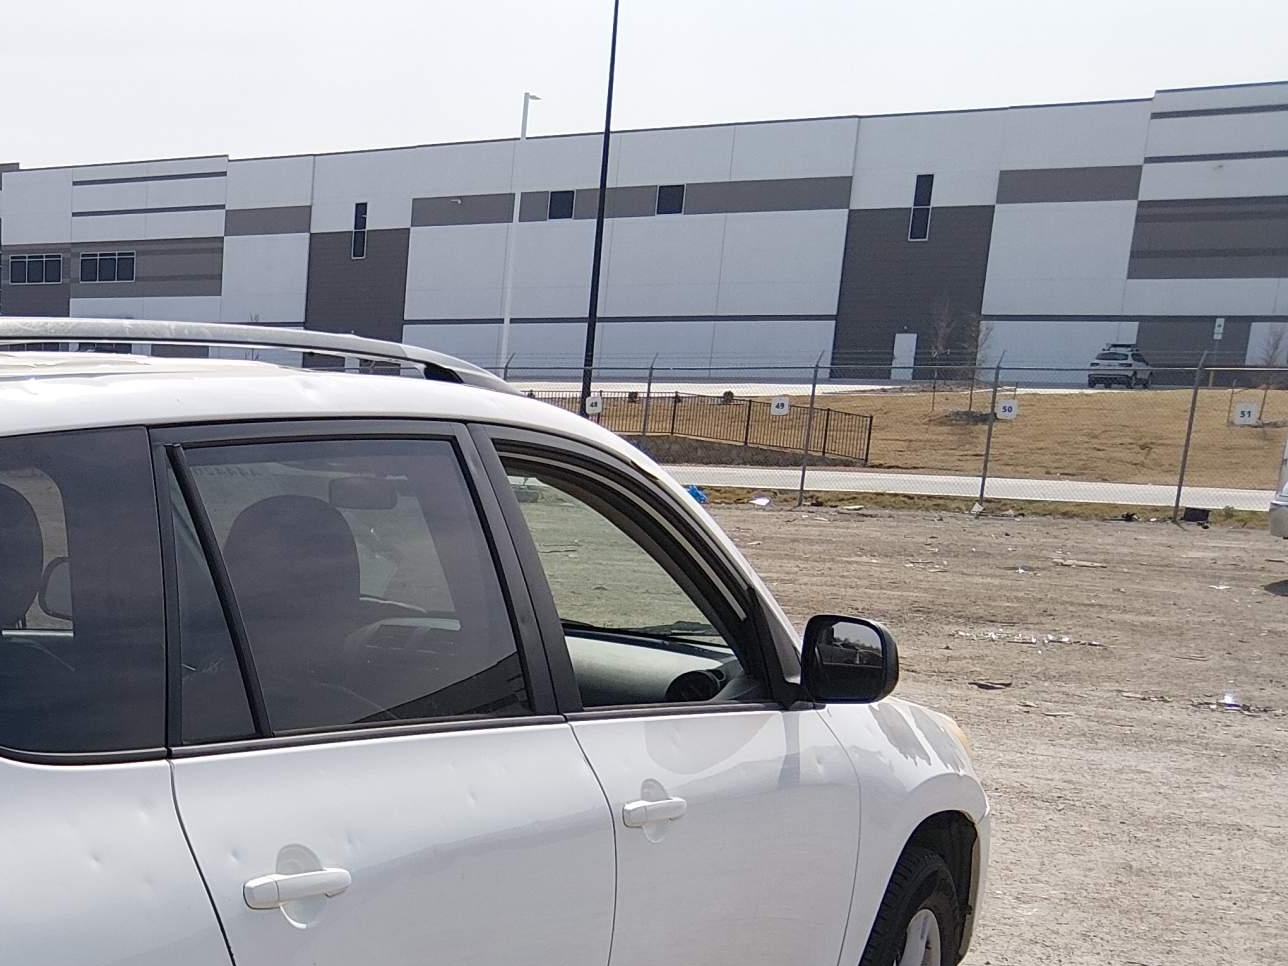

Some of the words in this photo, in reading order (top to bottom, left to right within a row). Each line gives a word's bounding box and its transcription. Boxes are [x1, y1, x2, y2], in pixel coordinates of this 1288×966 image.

[775, 402, 785, 410] 49
[1001, 405, 1013, 413] 50
[1239, 410, 1251, 418] 51
